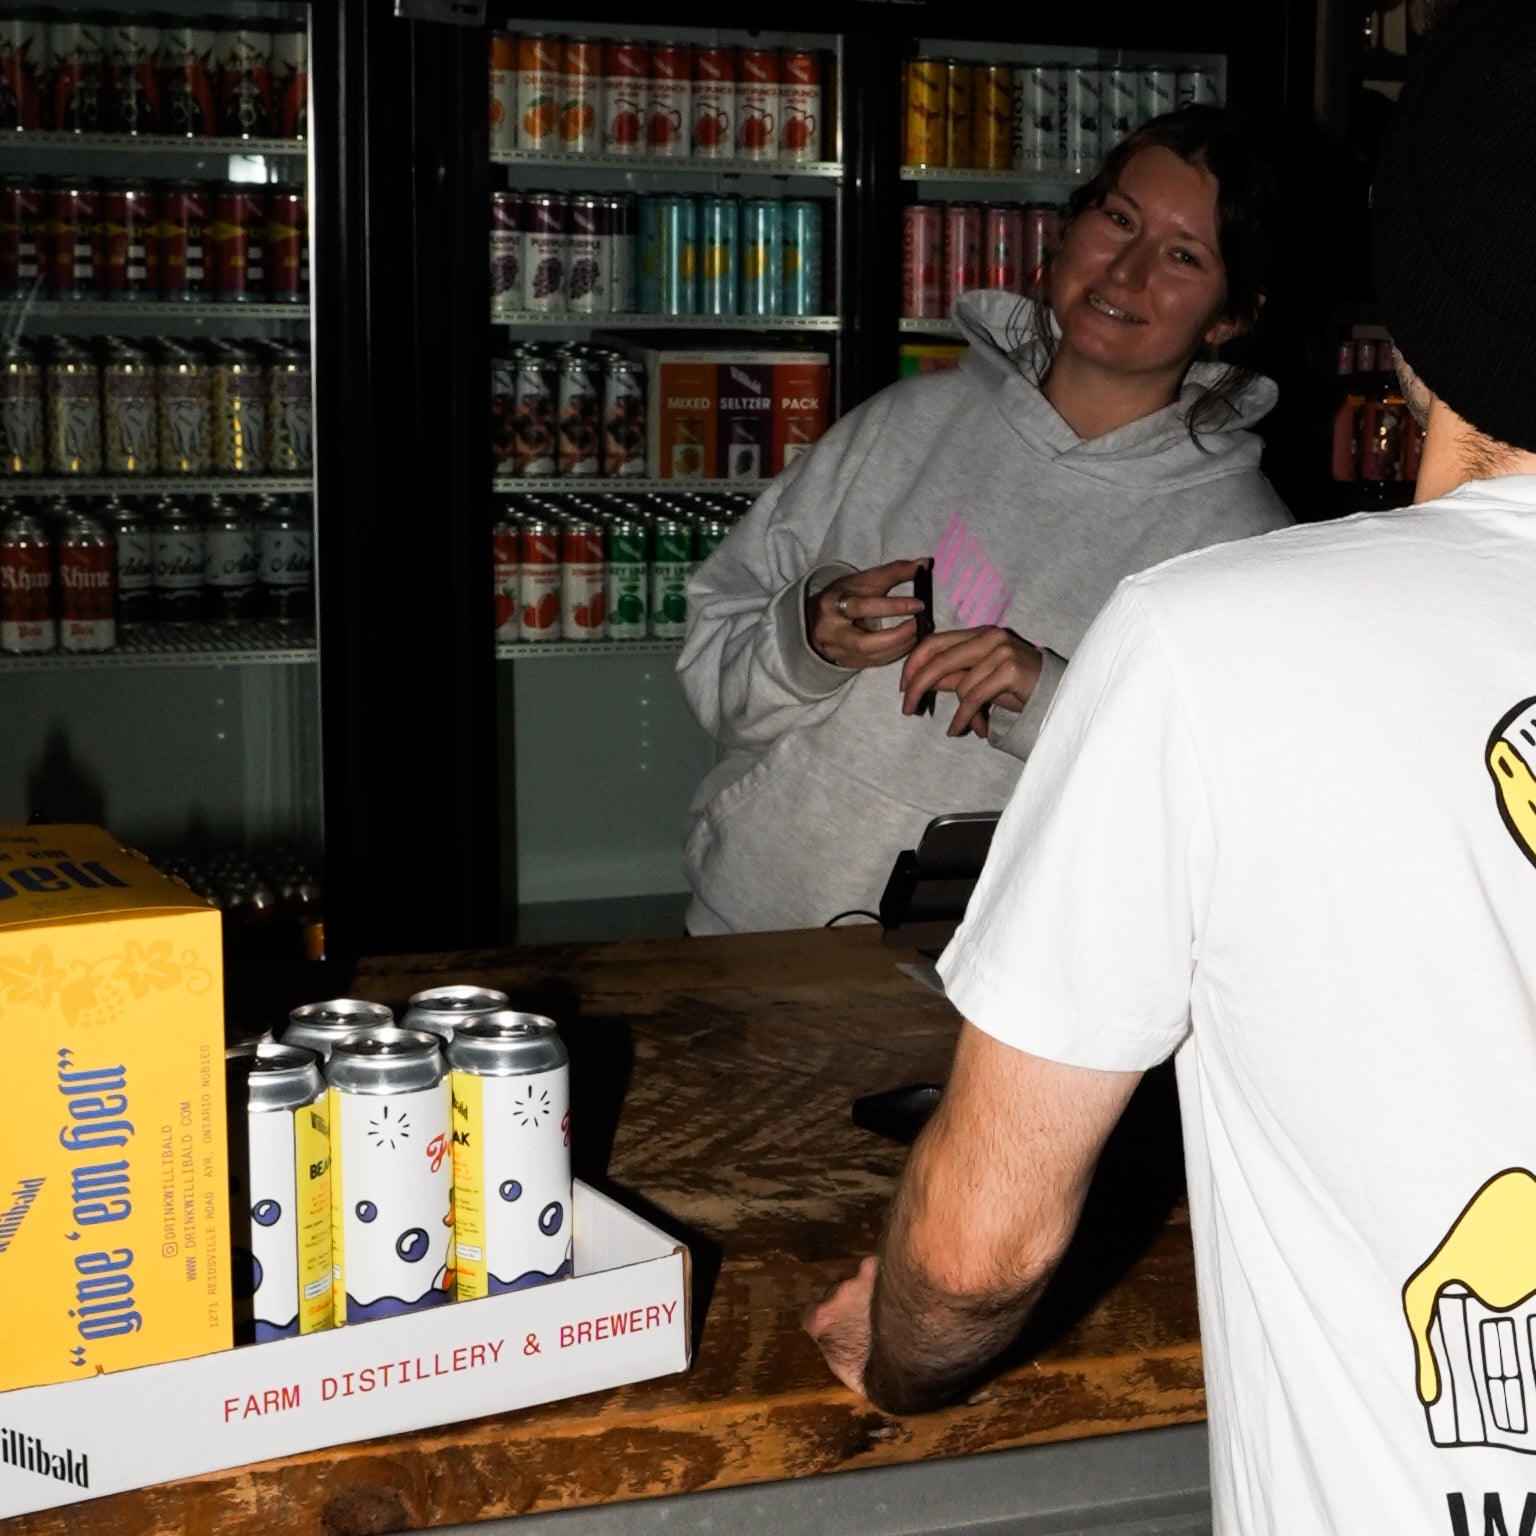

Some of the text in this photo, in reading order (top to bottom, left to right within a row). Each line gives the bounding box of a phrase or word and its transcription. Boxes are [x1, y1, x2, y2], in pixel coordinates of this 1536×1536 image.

[667, 396, 820, 410] MIXED SELTZER PACK
[201, 1093, 212, 1144] ONTARIO
[205, 1226, 217, 1295] REIDSVILLE
[209, 1301, 219, 1329] 1271
[224, 1300, 678, 1424] FARM DISTILLERY & BREWERY
[1, 1427, 90, 1489] illibald
